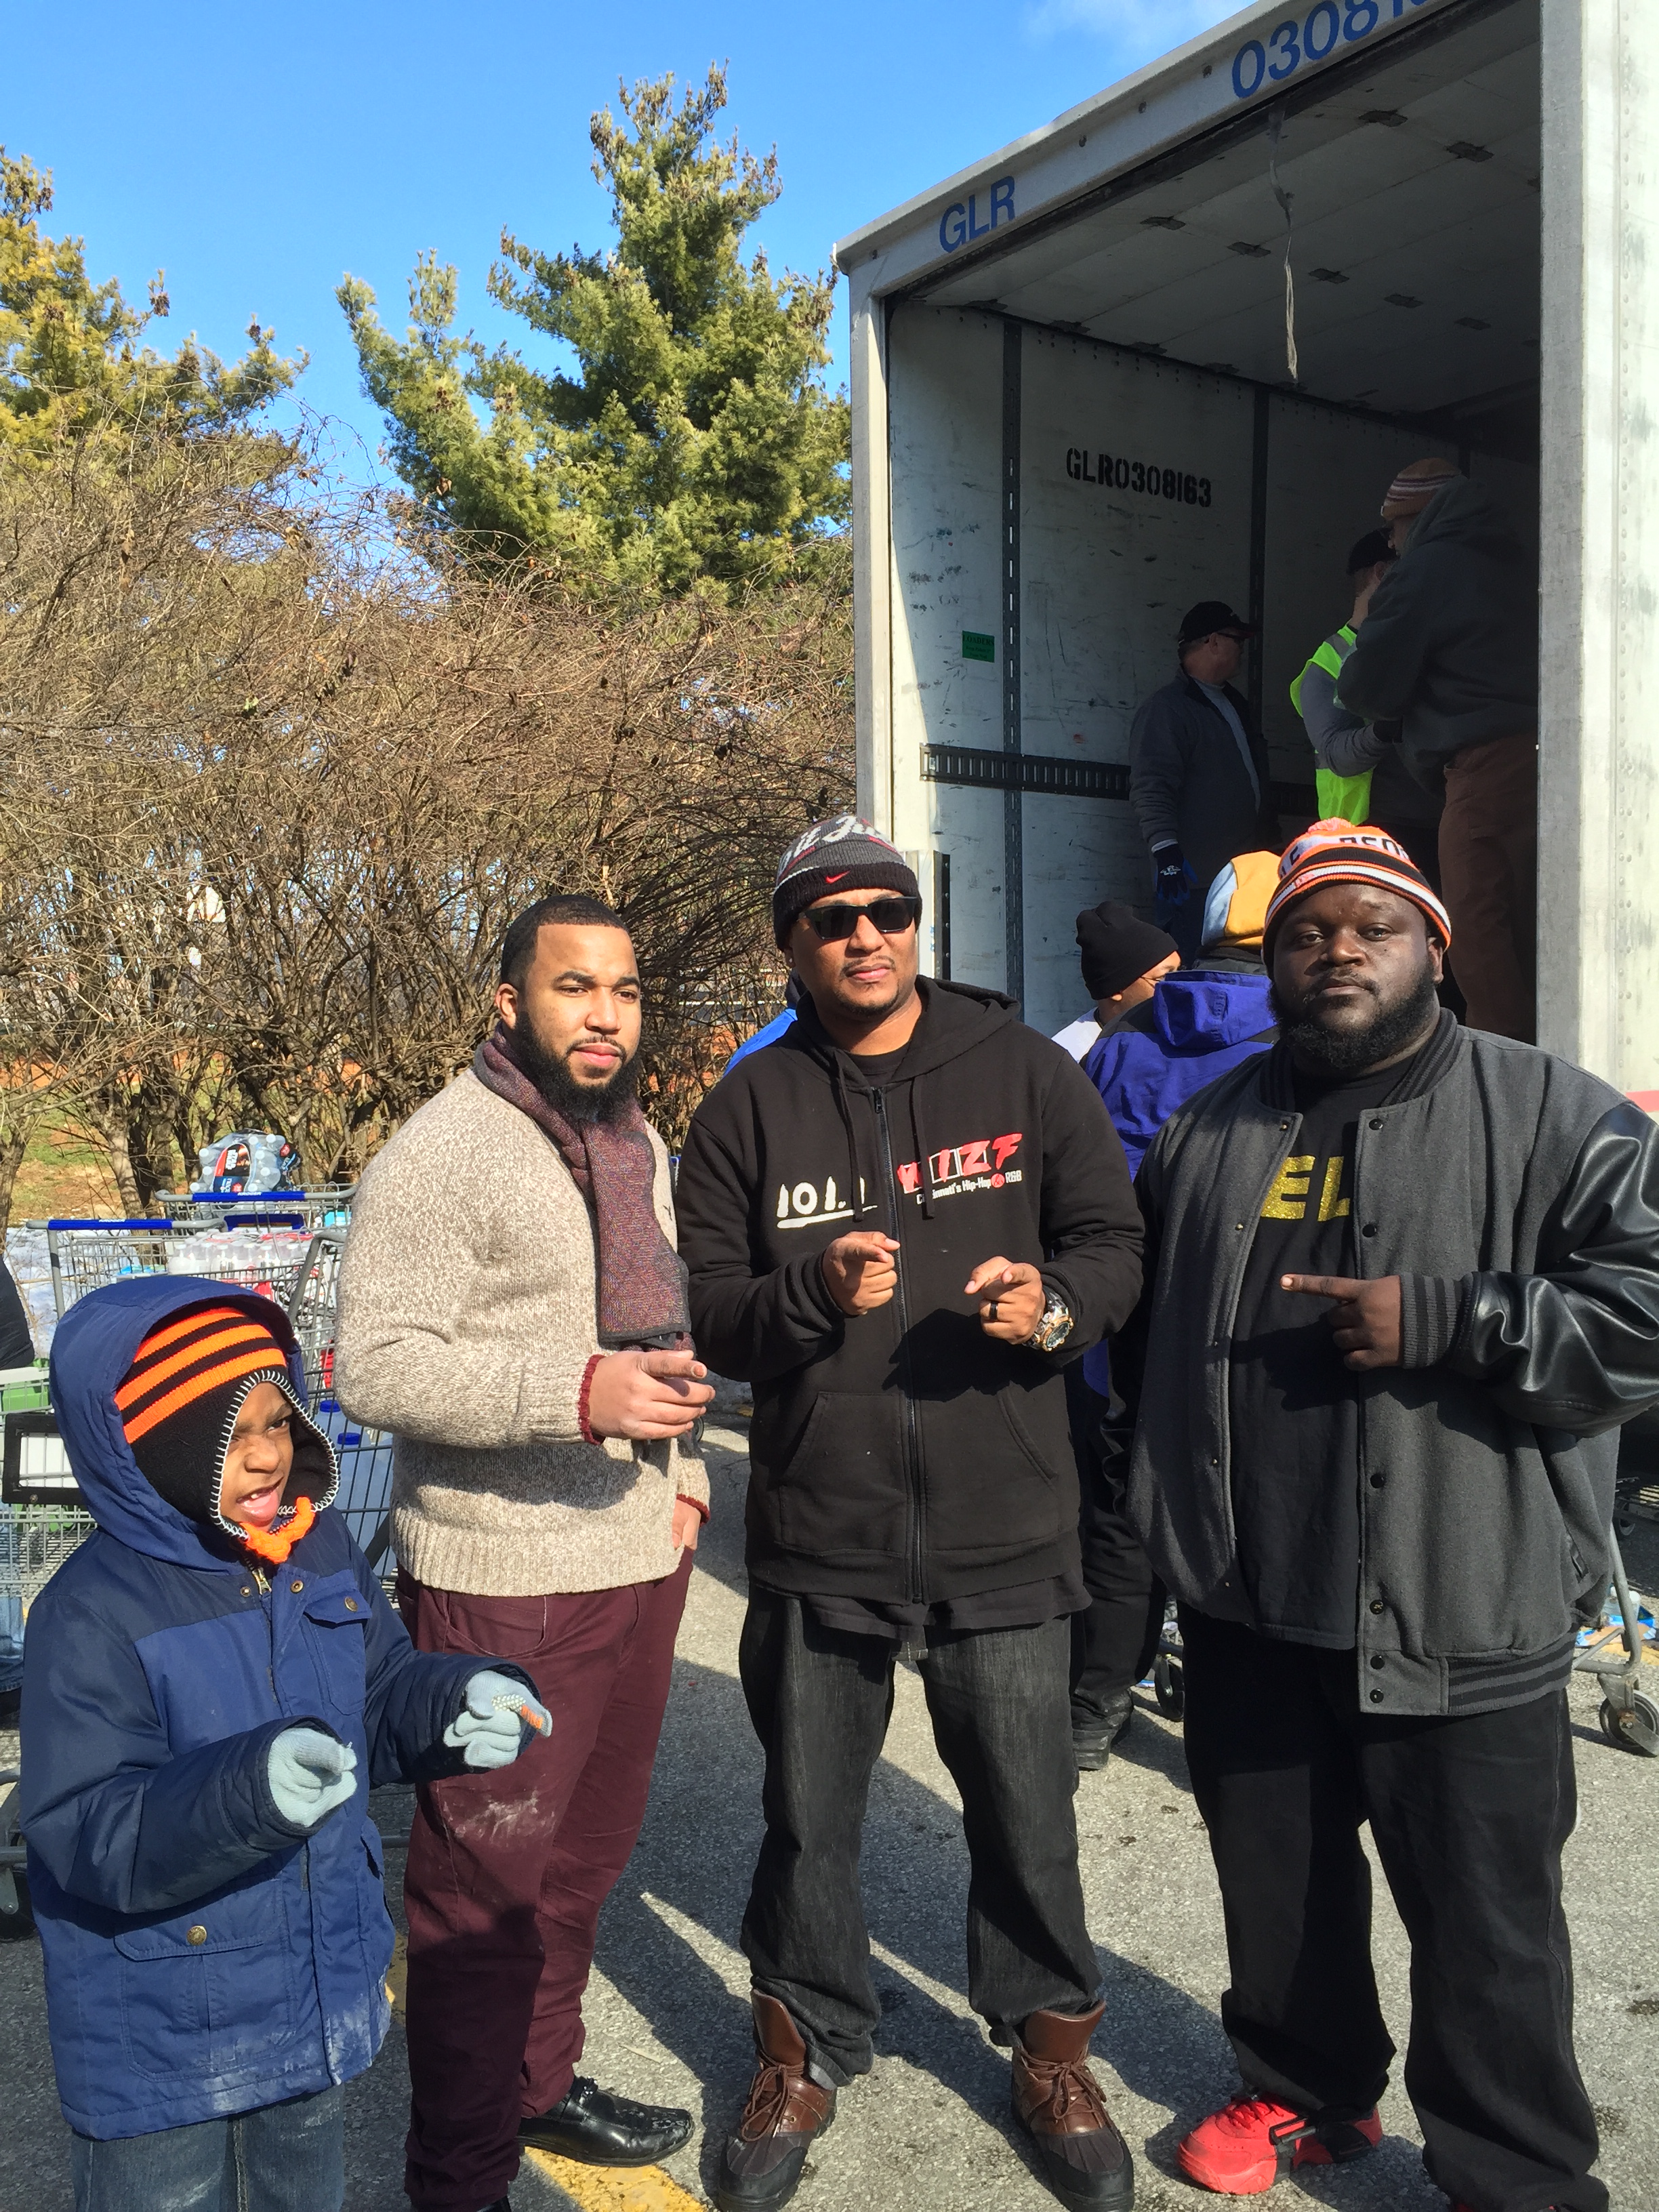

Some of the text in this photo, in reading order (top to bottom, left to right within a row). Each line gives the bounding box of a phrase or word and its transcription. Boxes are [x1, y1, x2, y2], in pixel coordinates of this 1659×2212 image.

[939, 0, 1424, 253] GLR 0308
[1066, 447, 1212, 508] GLR0308163
[916, 1183, 962, 1204] Ciinnati's
[962, 1176, 991, 1192] Hip-Hop
